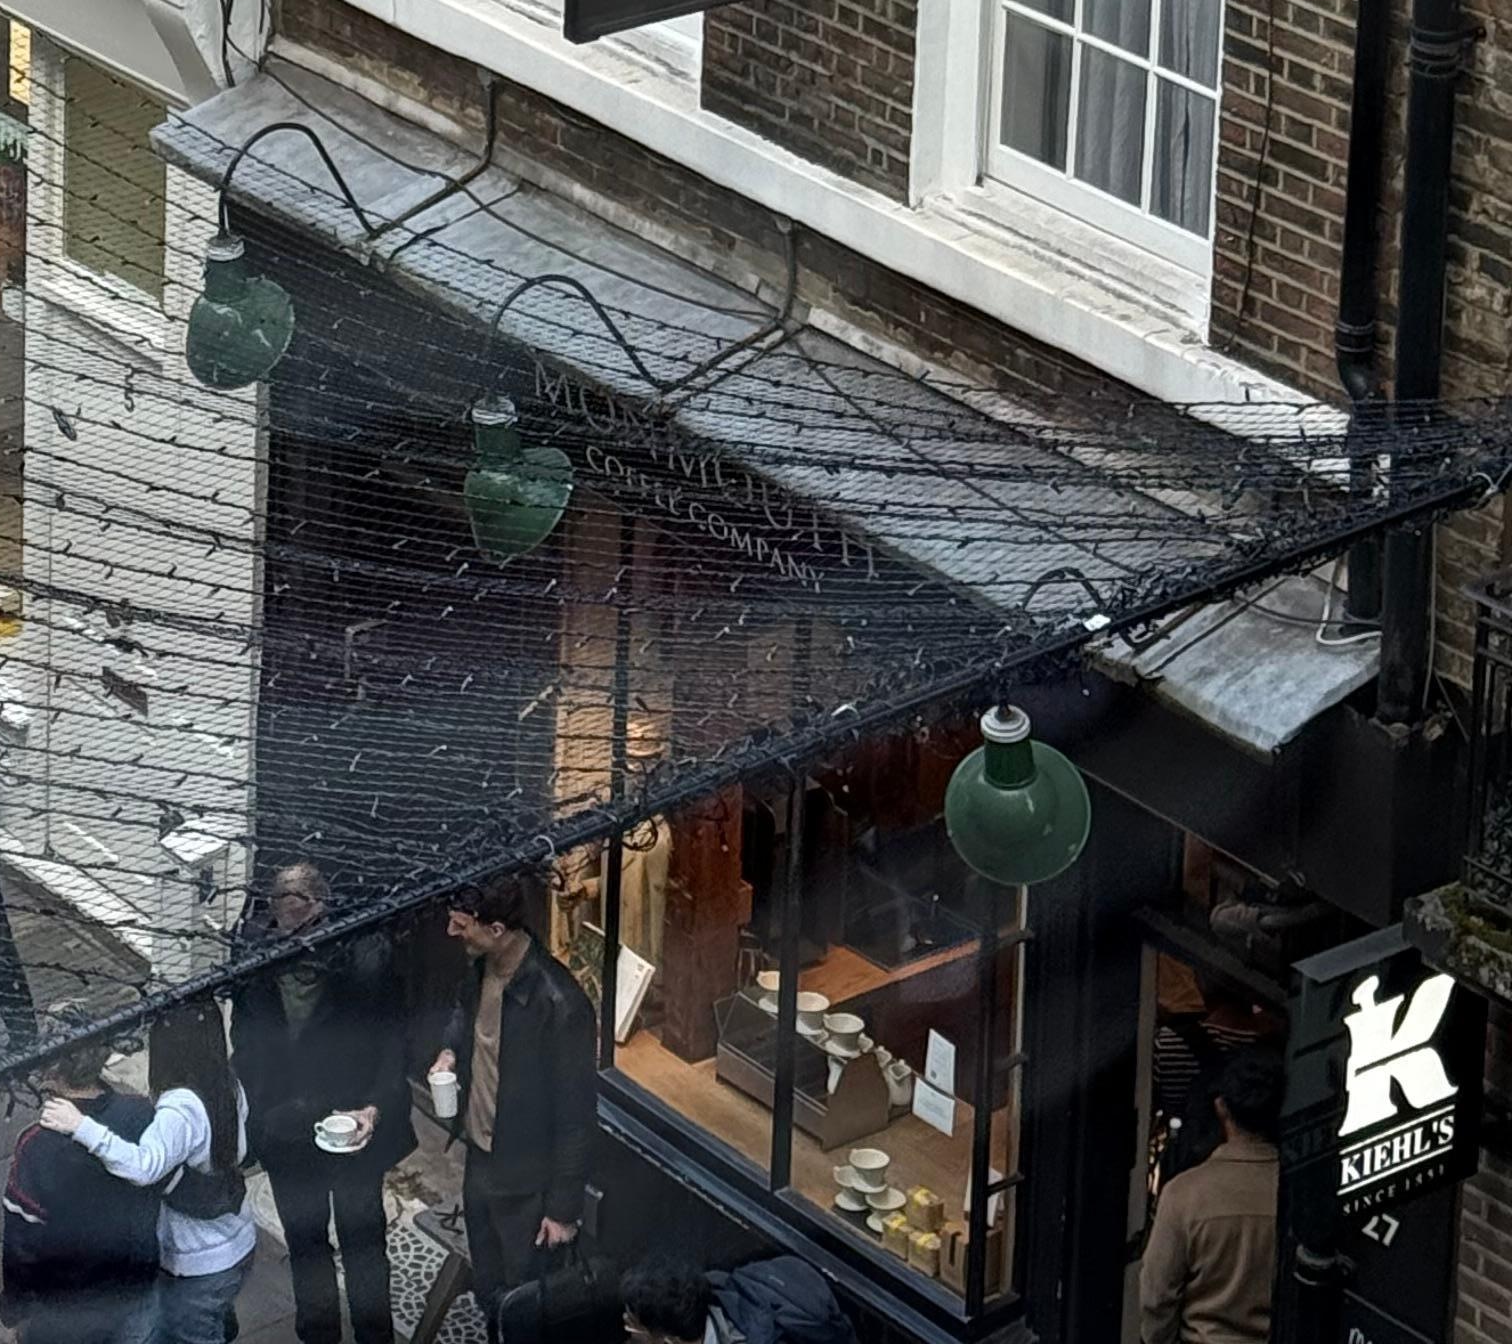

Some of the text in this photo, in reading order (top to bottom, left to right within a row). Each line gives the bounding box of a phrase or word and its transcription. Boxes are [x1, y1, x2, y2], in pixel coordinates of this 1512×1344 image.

[688, 502, 824, 594] COMPANY
[1341, 1115, 1455, 1185] KIEHL'S
[1342, 1184, 1397, 1216] SINCE
